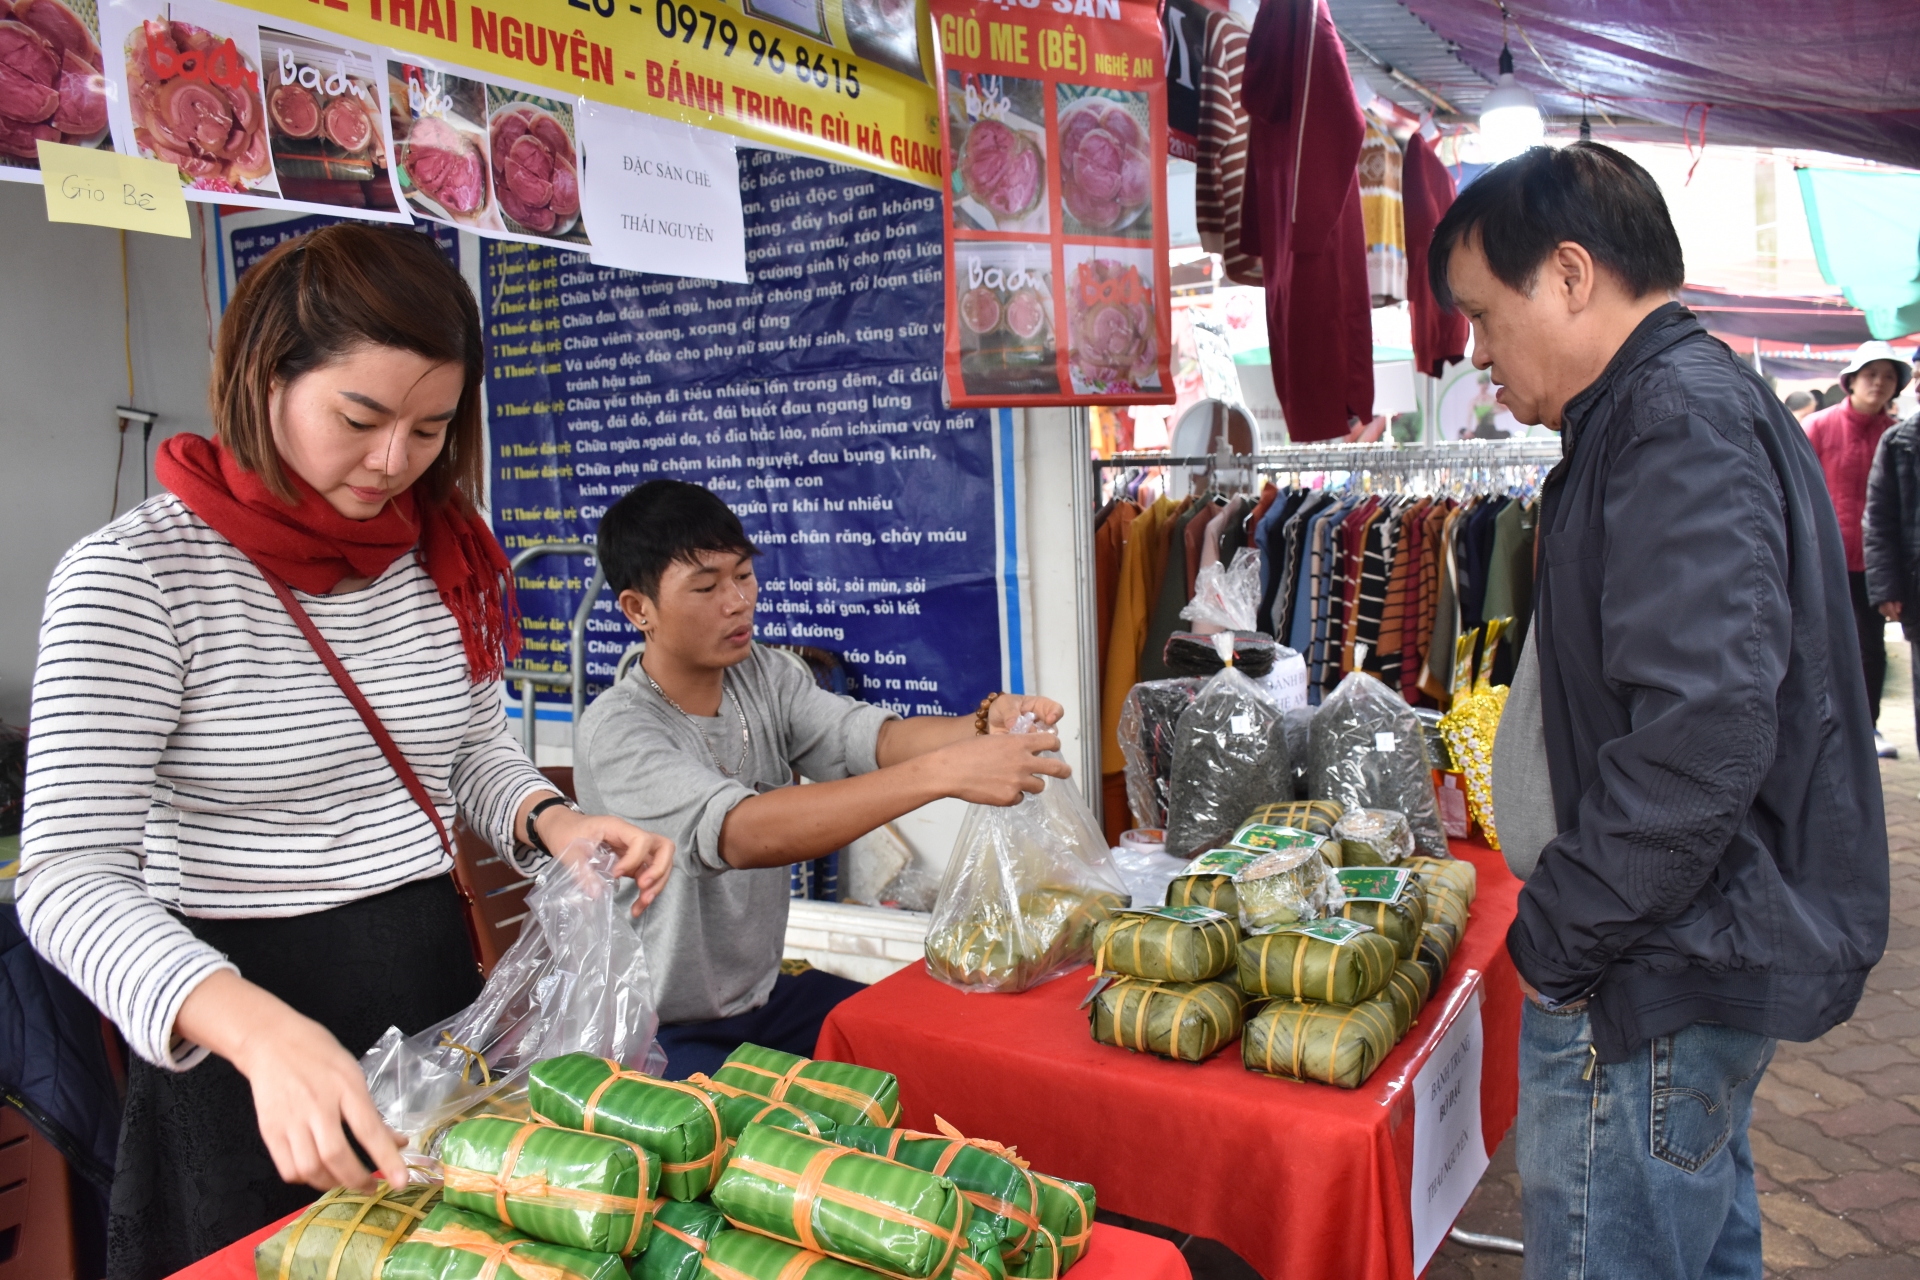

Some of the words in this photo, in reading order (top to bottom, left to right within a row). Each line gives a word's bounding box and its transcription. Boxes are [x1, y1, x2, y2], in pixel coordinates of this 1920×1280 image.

[656, 0, 738, 57] 0979
[749, 30, 785, 74] 96
[795, 46, 861, 99] 8615
[940, 9, 981, 59] GIÒ
[990, 23, 1029, 65] ME
[1038, 26, 1087, 76] (BÊ)
[1095, 52, 1129, 82] NGHỆ
[1132, 58, 1153, 78] AN
[471, 6, 614, 86] NGUYÊN
[645, 60, 724, 116] BÁNH
[732, 86, 813, 135] TRƯNG
[821, 111, 850, 148] GÙ
[857, 123, 884, 161] HÀ
[623, 155, 653, 176] ĐẶC
[790, 166, 825, 182] theo
[123, 183, 157, 211] Bê
[806, 188, 837, 206] độc
[843, 183, 874, 201] gan
[858, 209, 877, 220] ăn
[882, 198, 935, 214] không
[621, 213, 654, 233] THÁI
[658, 220, 714, 242] NGUYÊN
[787, 242, 805, 254] ra
[810, 236, 849, 253] máu,
[854, 230, 880, 245] táo
[886, 223, 917, 237] bón
[806, 258, 834, 275] sinh
[853, 253, 879, 267] cho
[560, 271, 594, 286] Chữa
[561, 293, 591, 306] Chữa
[610, 284, 639, 301] thận
[563, 312, 593, 329] Chữa
[707, 297, 732, 310] hoa
[767, 286, 813, 303] chóng
[564, 334, 598, 351] Chữa
[602, 331, 632, 347] viêm
[636, 326, 685, 343] xoang,
[689, 322, 736, 335] xoang
[565, 358, 583, 371] Và
[675, 347, 700, 360] cho
[758, 342, 784, 354] sau
[789, 335, 812, 350] khi
[816, 331, 851, 346] sinh,
[856, 326, 894, 342] tăng
[567, 396, 600, 412] Chữa
[631, 390, 662, 409] thận
[665, 388, 679, 403] đi
[793, 379, 837, 392] trong
[842, 373, 882, 389] đêm,
[888, 369, 904, 384] đi
[911, 366, 938, 384] đái
[568, 416, 603, 433] vàng,
[608, 413, 627, 429] đái
[713, 405, 737, 420] đái
[781, 400, 811, 415] đau
[816, 398, 868, 415] ngang
[872, 394, 912, 410] lưng
[576, 440, 607, 454] Chữa
[680, 432, 701, 447] da,
[780, 425, 807, 440] lào,
[576, 462, 611, 477] Chữa
[706, 454, 742, 470] kinh
[808, 450, 839, 464] đau
[843, 447, 885, 466] bụng
[890, 445, 937, 461] kinh,
[579, 483, 607, 496] kinh
[795, 476, 823, 487] con
[772, 501, 788, 513] ra
[791, 529, 830, 544] chân
[836, 529, 877, 546] răng,
[928, 527, 967, 543] máu
[765, 577, 785, 591] các
[839, 601, 870, 617] gan,
[585, 618, 621, 632] Chữa
[763, 622, 787, 637] đái
[791, 622, 844, 641] đường
[587, 640, 622, 654] Chữa
[843, 648, 870, 664] táo
[875, 650, 907, 665] bón
[863, 675, 881, 689] ho
[886, 677, 901, 690] ra
[905, 676, 937, 692] máu
